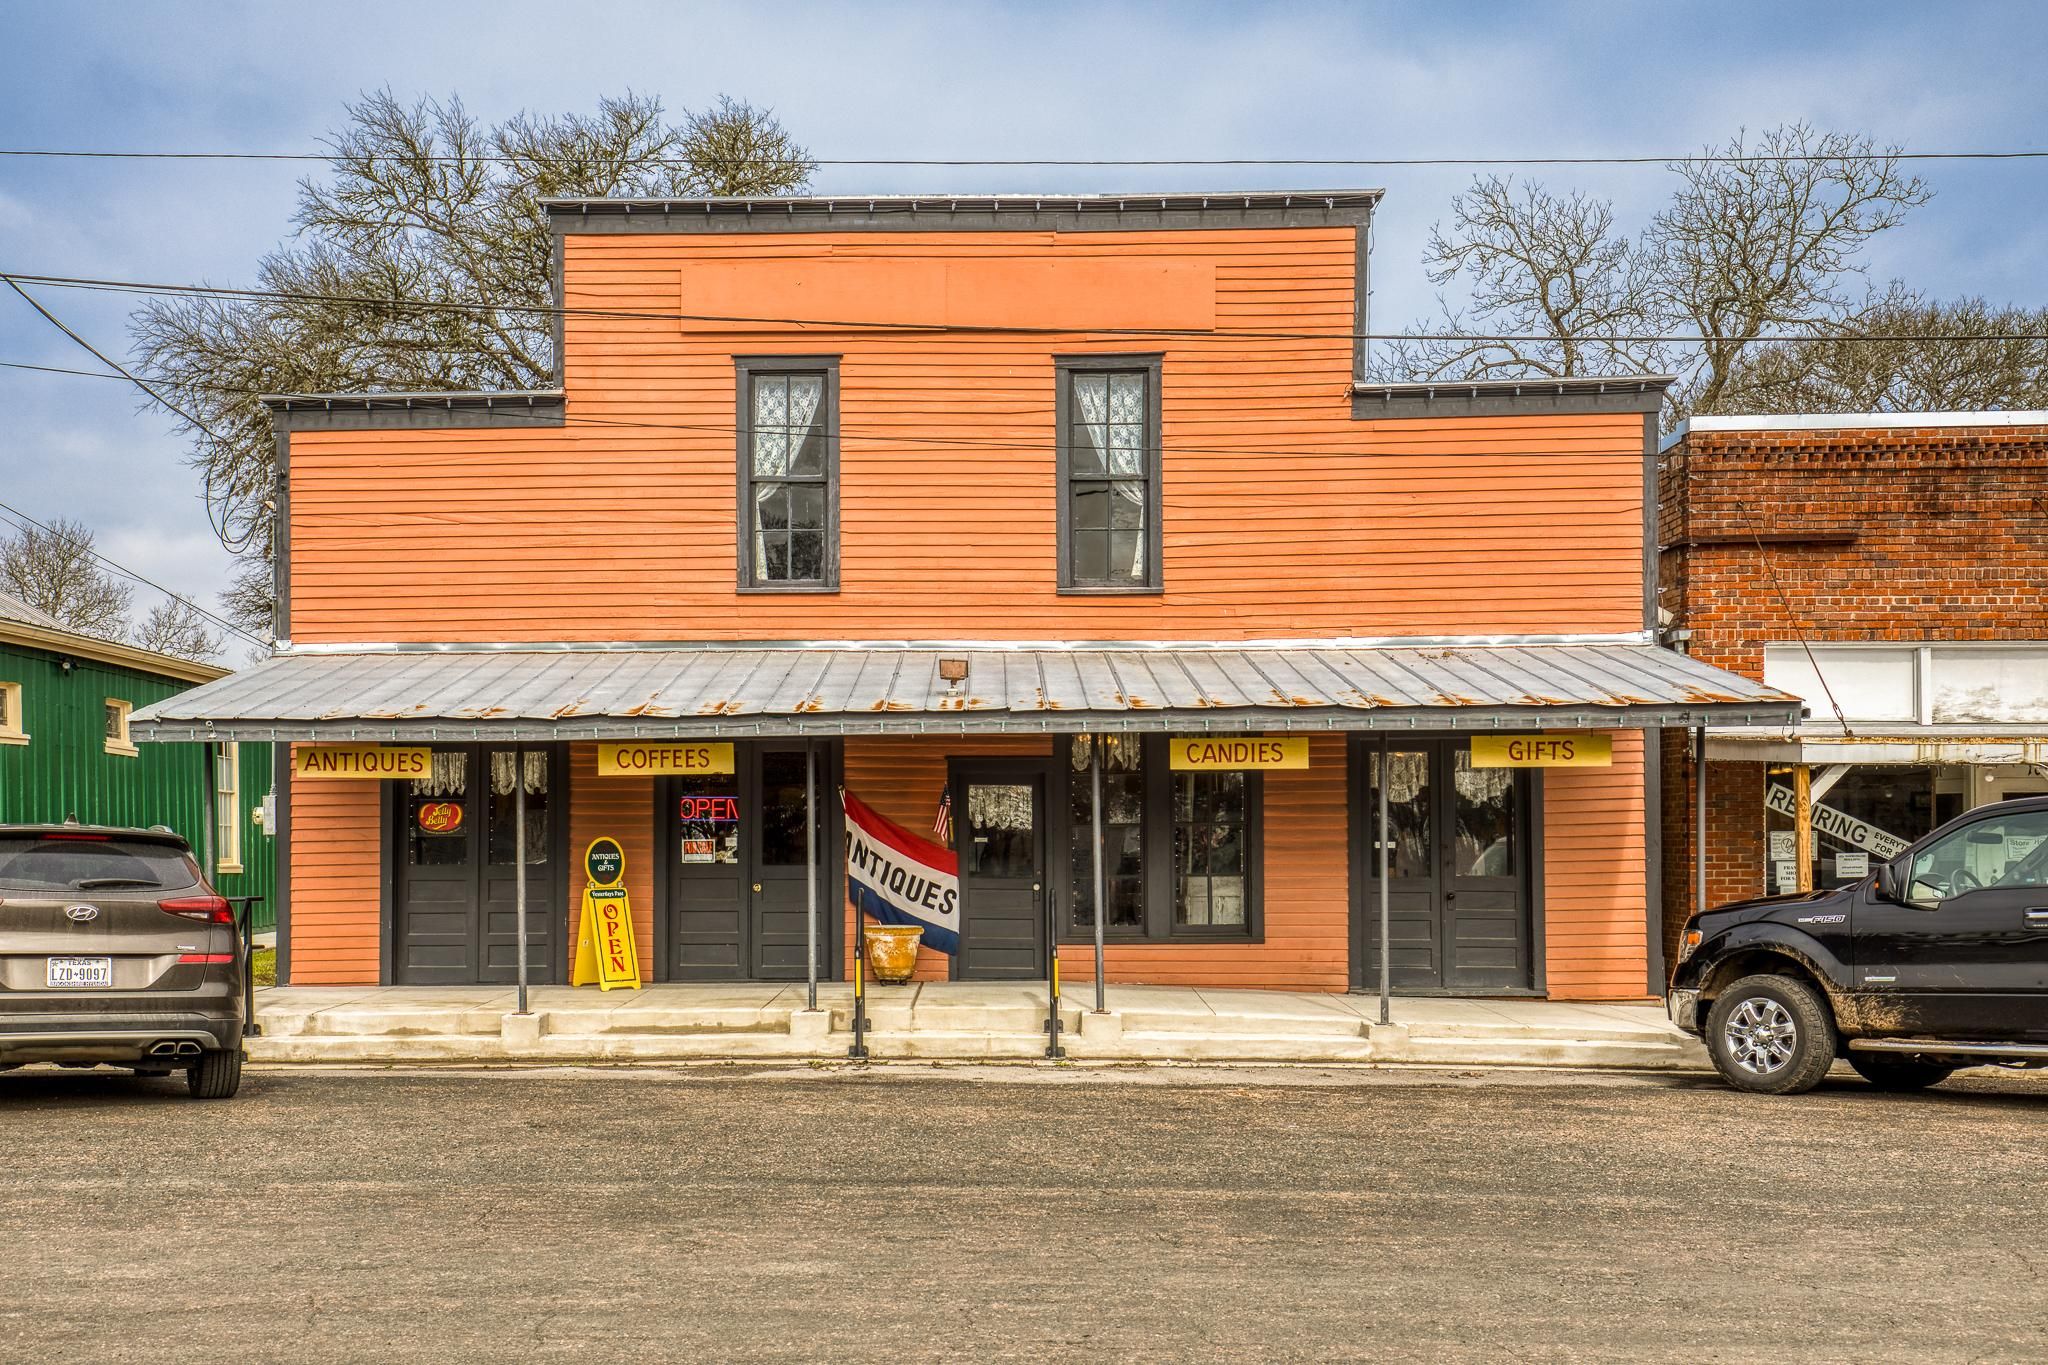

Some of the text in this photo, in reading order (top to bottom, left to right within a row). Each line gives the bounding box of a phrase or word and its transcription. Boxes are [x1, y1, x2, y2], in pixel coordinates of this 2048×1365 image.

[616, 748, 710, 769] COFFEES
[1186, 743, 1283, 763] CANDIES
[1508, 740, 1574, 760] GIFTS
[304, 752, 424, 772] ANTIQUES
[432, 807, 452, 817] Jelly
[681, 798, 738, 819] OPEN
[1769, 788, 1868, 844] REIRING
[425, 815, 448, 825] Belly
[1874, 832, 1909, 850] EVERYT
[1875, 843, 1892, 855] FOR
[603, 903, 626, 973] OPEN
